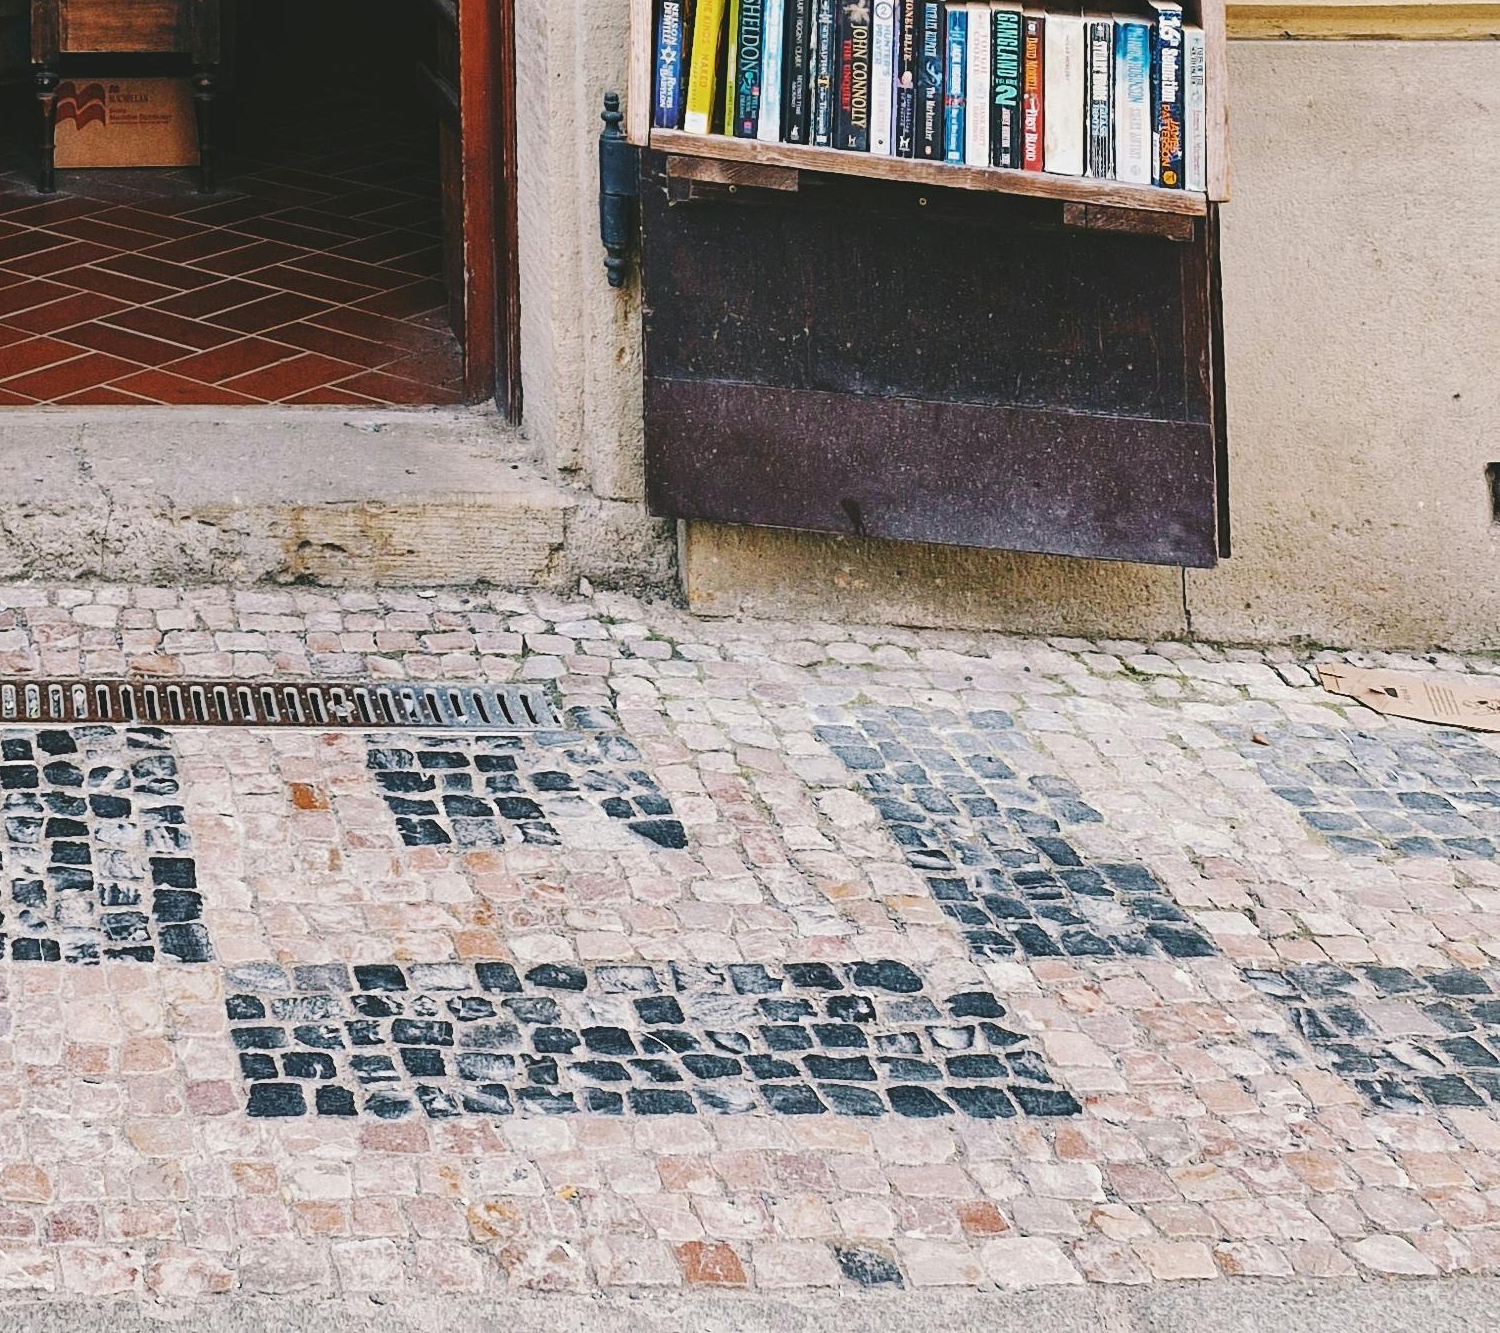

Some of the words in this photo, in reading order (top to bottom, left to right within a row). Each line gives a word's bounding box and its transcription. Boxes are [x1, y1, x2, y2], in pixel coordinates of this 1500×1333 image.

[843, 39, 851, 61] THE
[851, 23, 868, 58] JOHN
[973, 31, 981, 75] COOKIE
[996, 13, 1018, 77] GANGLAND
[700, 54, 710, 88] NAKED
[842, 64, 850, 112] UNQUIET
[1162, 49, 1178, 102] Seduction
[851, 62, 868, 129] CONNOLLY
[995, 86, 1017, 106] 2
[1026, 109, 1037, 130] FIRST
[1161, 105, 1171, 166] PATTERSON
[1170, 120, 1180, 152] JAMES
[1026, 133, 1038, 161] BLOOD
